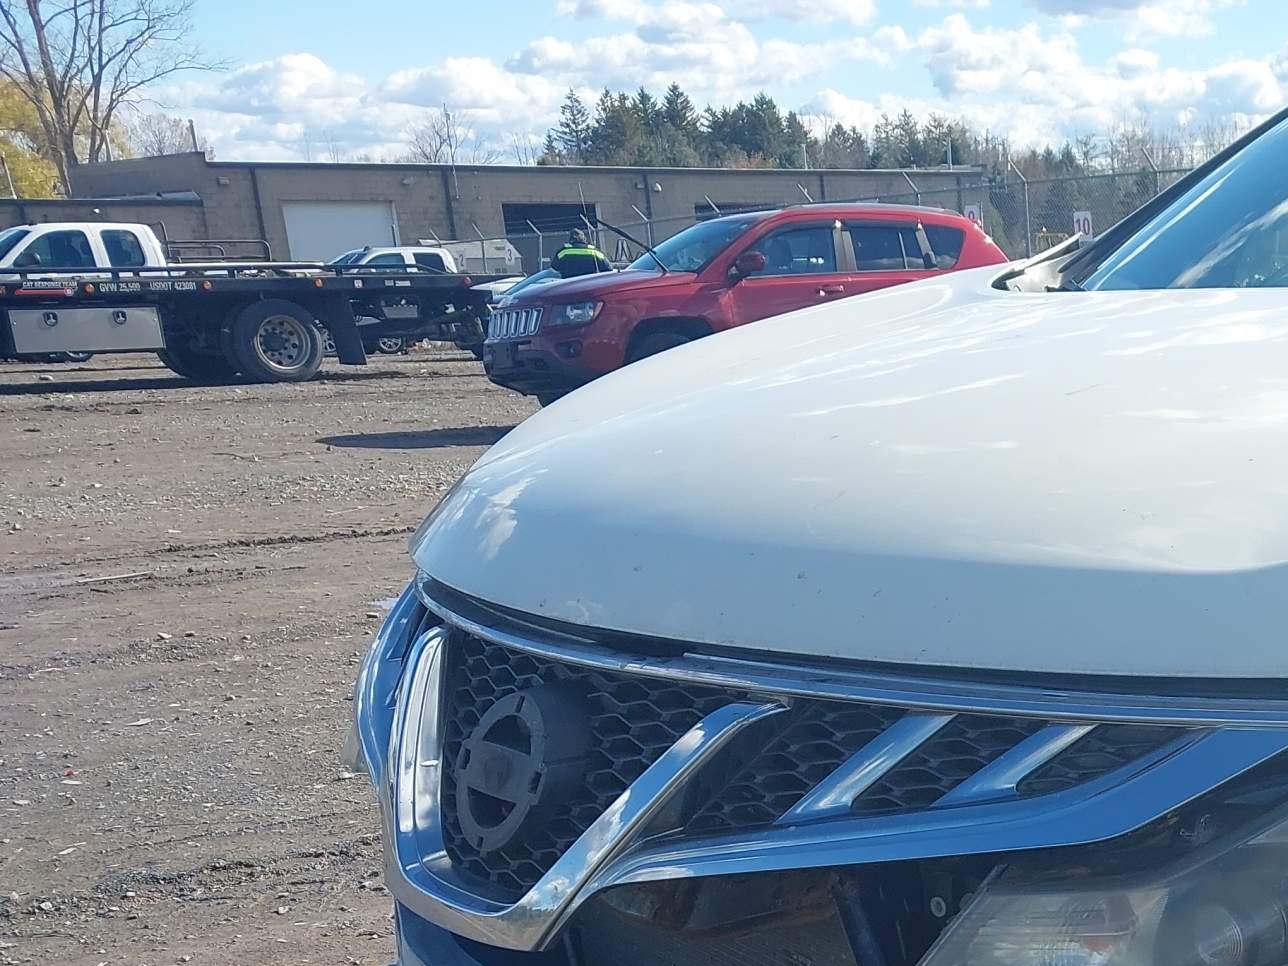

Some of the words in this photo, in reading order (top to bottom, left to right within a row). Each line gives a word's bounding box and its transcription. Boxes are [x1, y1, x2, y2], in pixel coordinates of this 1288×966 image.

[1075, 217, 1090, 235] 10
[459, 254, 464, 267] 2
[507, 249, 512, 262] 3
[99, 283, 117, 292] GVW
